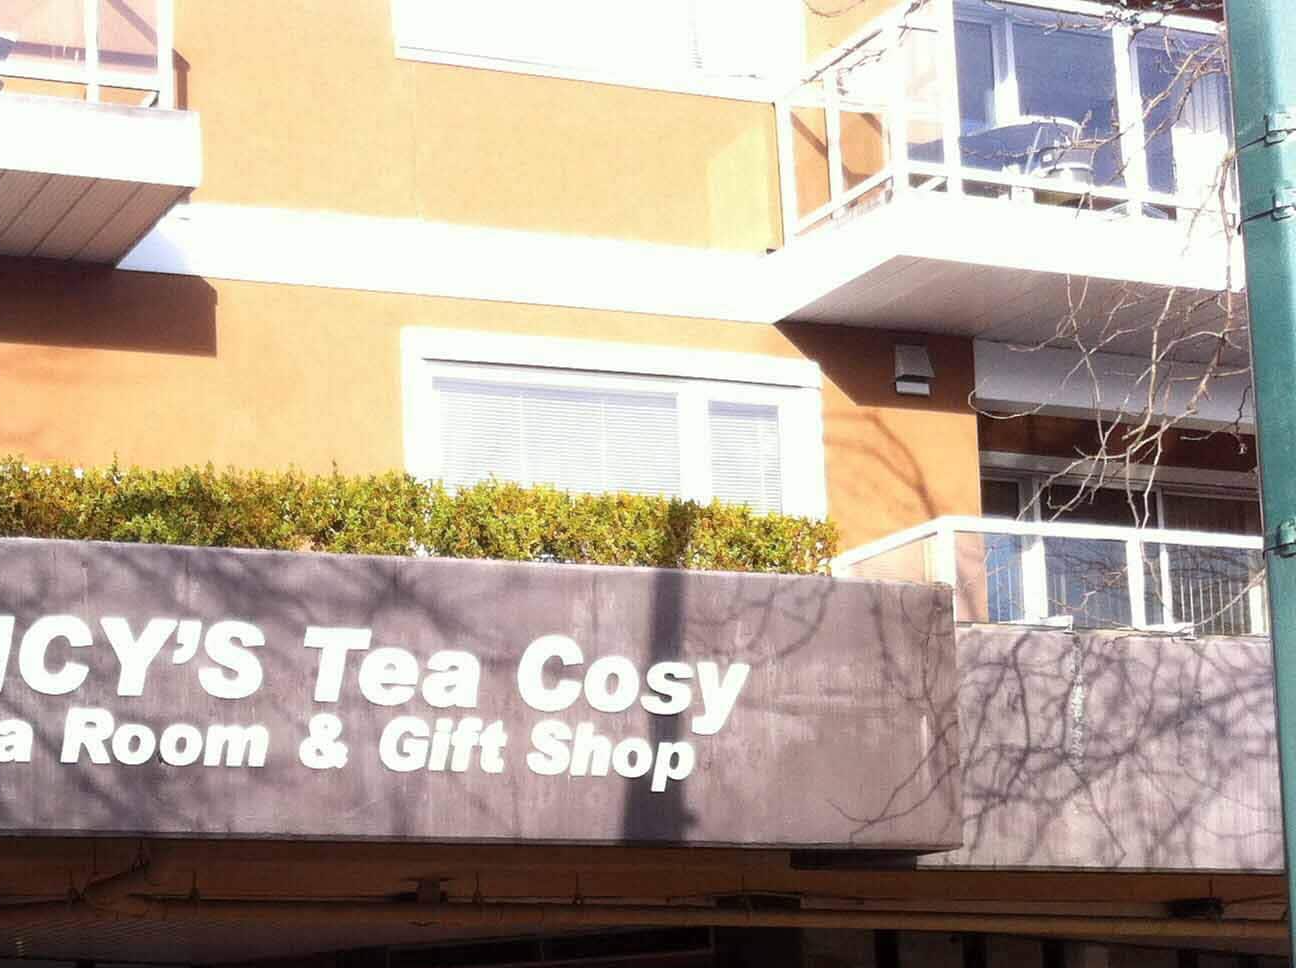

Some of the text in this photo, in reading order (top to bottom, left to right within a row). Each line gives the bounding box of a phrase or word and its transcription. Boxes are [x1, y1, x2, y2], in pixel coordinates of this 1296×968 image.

[304, 626, 481, 709] Tea
[516, 634, 751, 735] Cosy
[60, 706, 270, 767] Room
[299, 711, 349, 770] &
[378, 715, 509, 774] Gift
[526, 717, 696, 792] Shop
